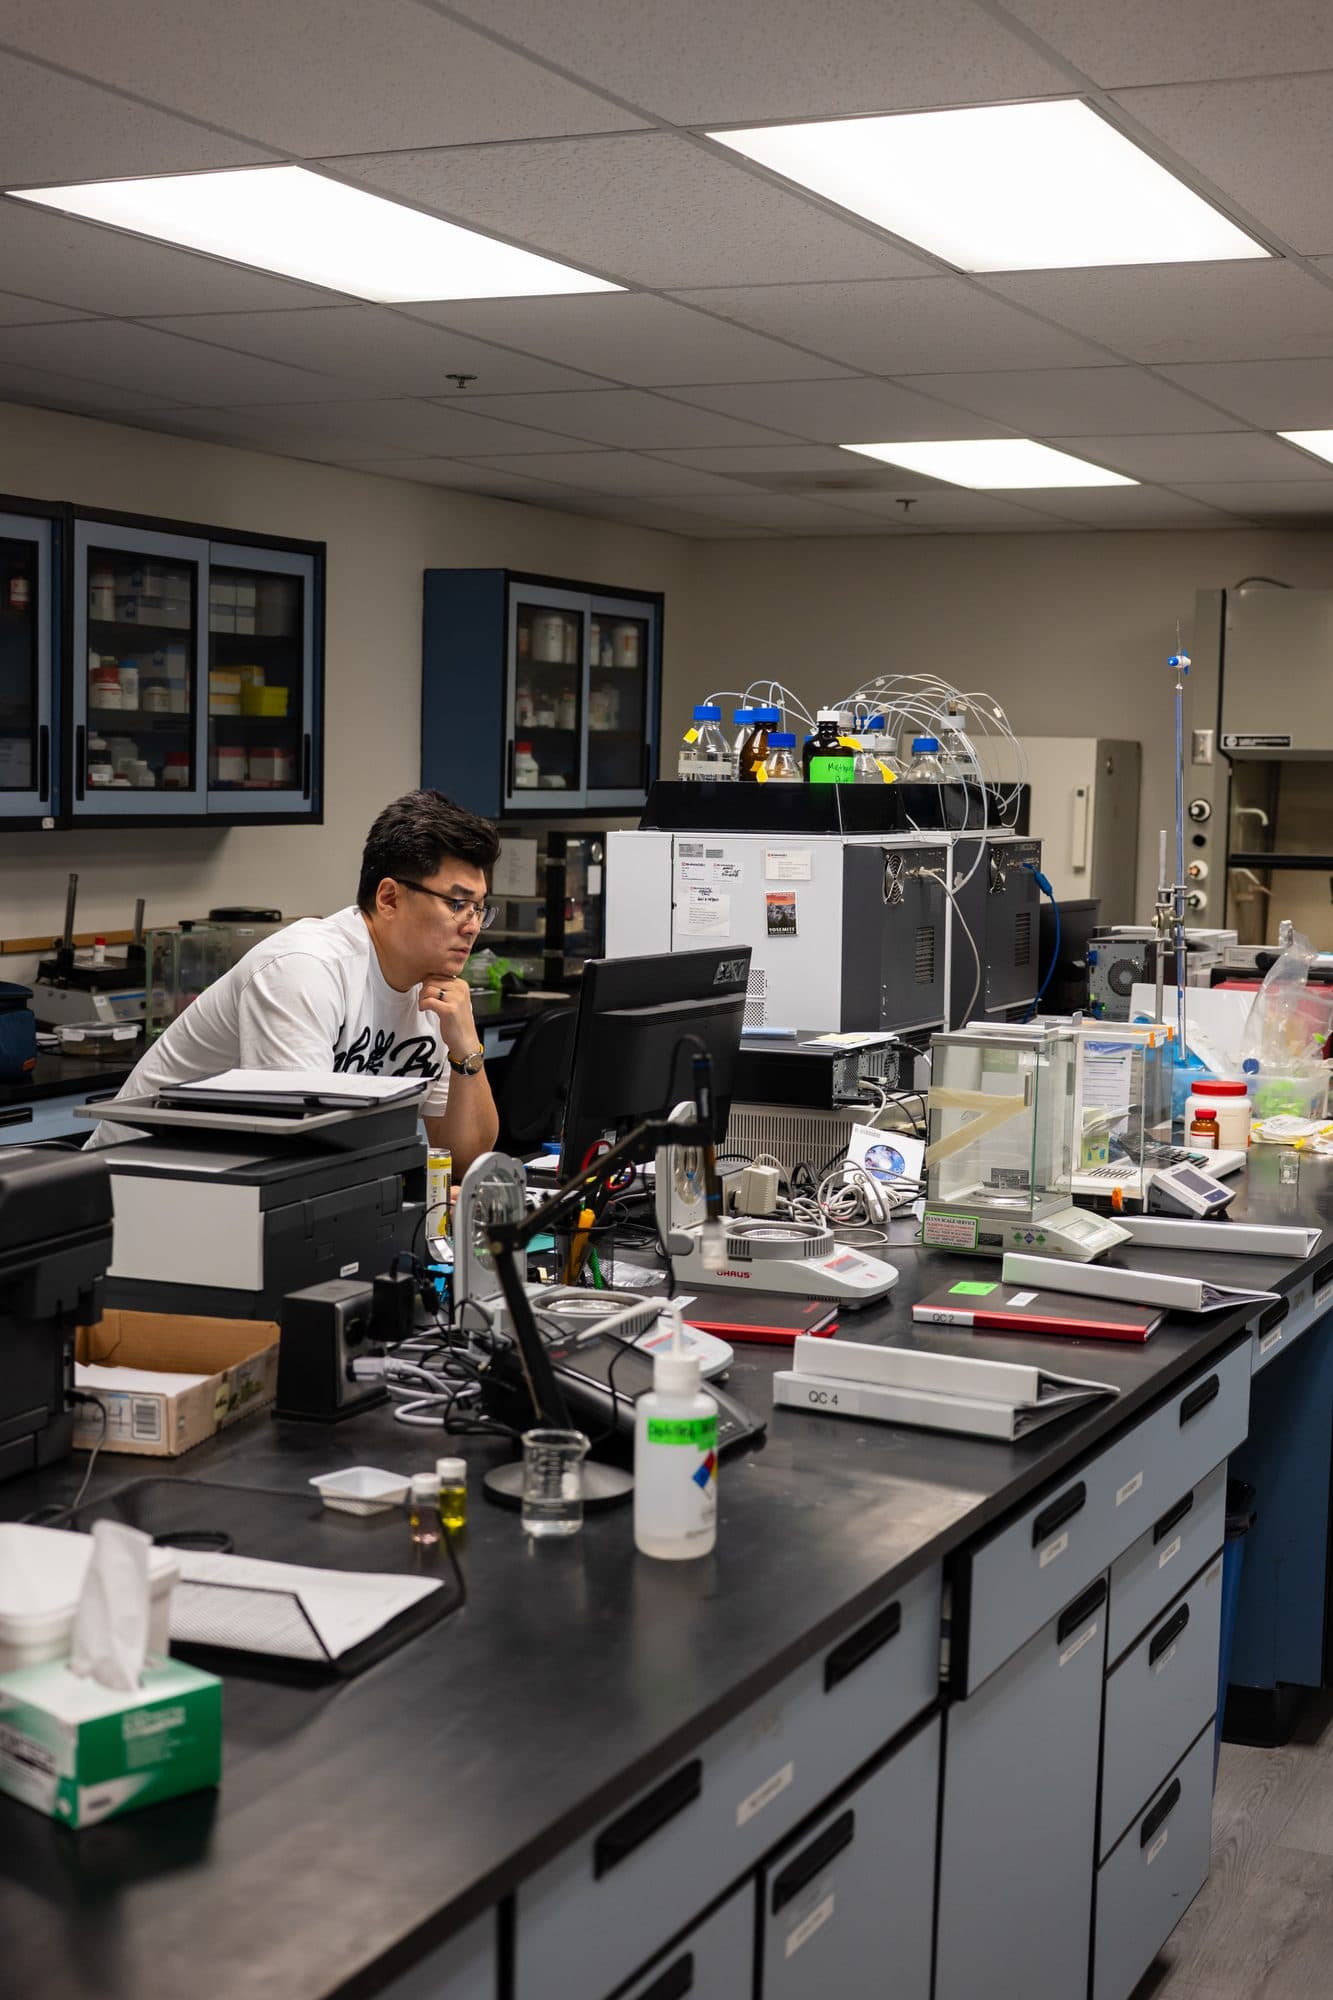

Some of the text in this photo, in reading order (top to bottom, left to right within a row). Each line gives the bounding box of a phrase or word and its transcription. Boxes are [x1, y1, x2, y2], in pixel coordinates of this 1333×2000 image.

[932, 1313, 955, 1323] QC 2
[808, 1390, 839, 1406] QC 4
